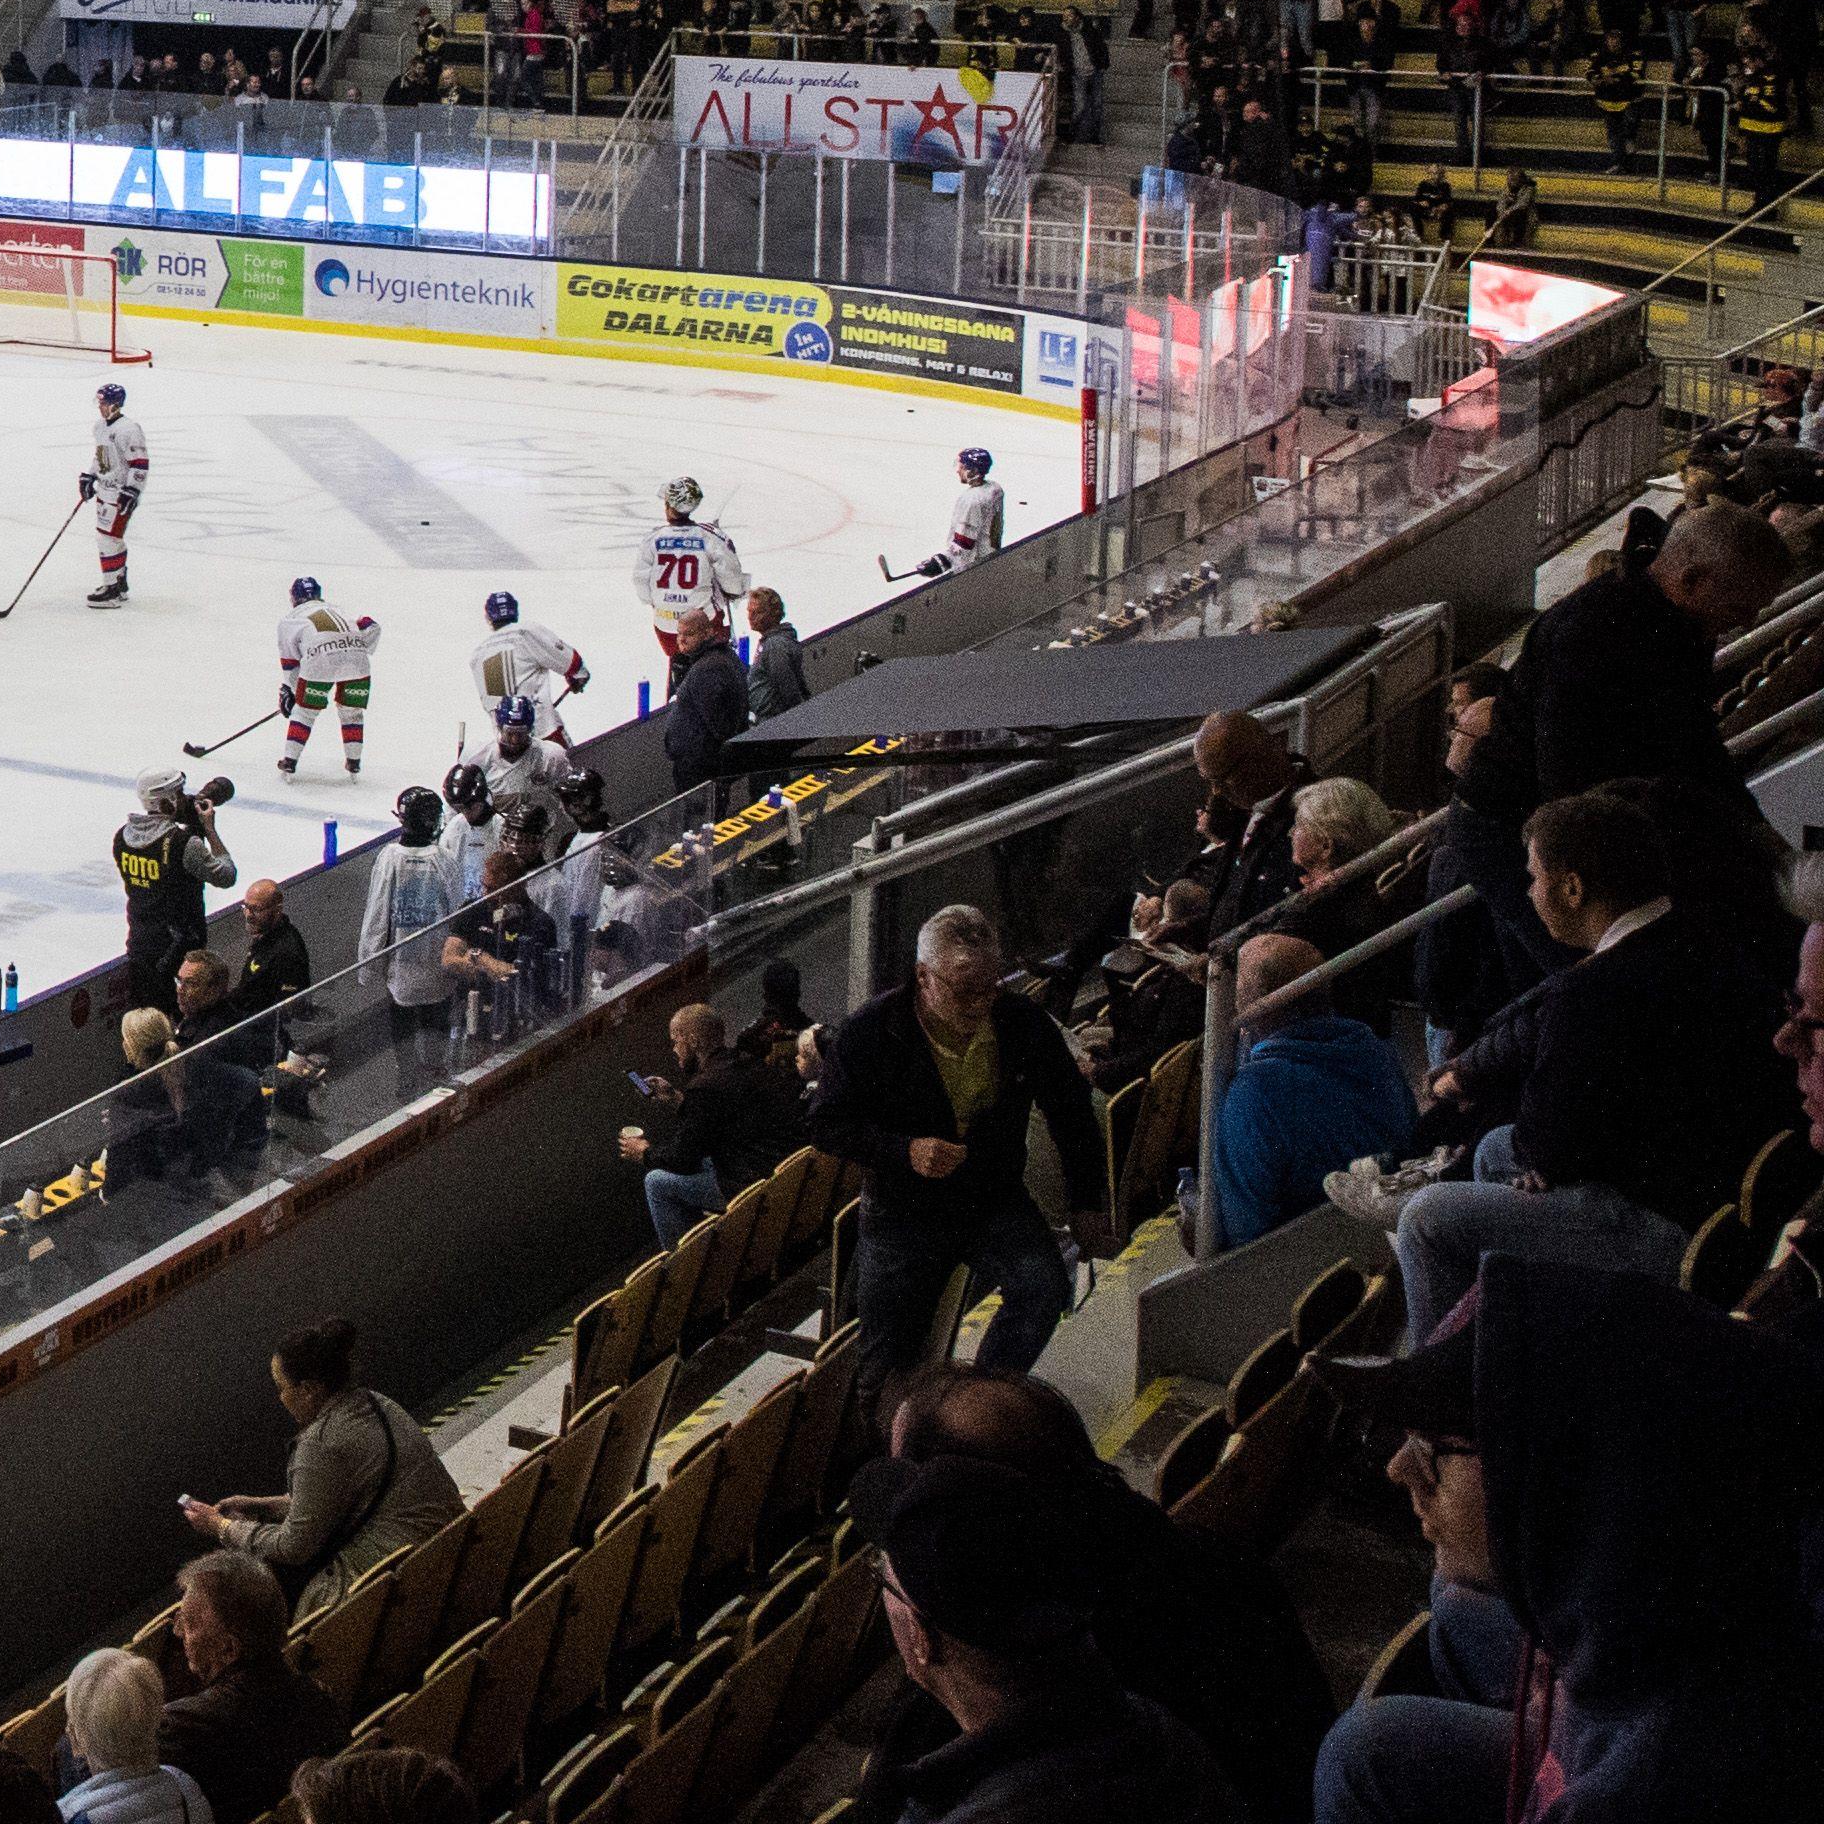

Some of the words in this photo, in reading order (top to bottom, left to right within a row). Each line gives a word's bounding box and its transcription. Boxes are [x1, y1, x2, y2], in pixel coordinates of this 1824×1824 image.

[709, 63, 734, 83] The
[735, 66, 794, 88] fabulous
[798, 72, 860, 93] sportsbar
[114, 147, 427, 225] ALFAB
[158, 251, 207, 278] RÖR
[243, 269, 284, 287] bättre
[244, 254, 266, 269] För
[269, 259, 288, 270] en
[356, 270, 536, 310] Hygienteknik
[567, 274, 818, 318] Gokartarena
[603, 310, 774, 347] DALARNA
[841, 303, 1016, 343] 2-VÅNINGSBANA
[841, 328, 947, 356] INOMHUS!
[657, 553, 699, 590] 70
[121, 852, 160, 881] FOTO
